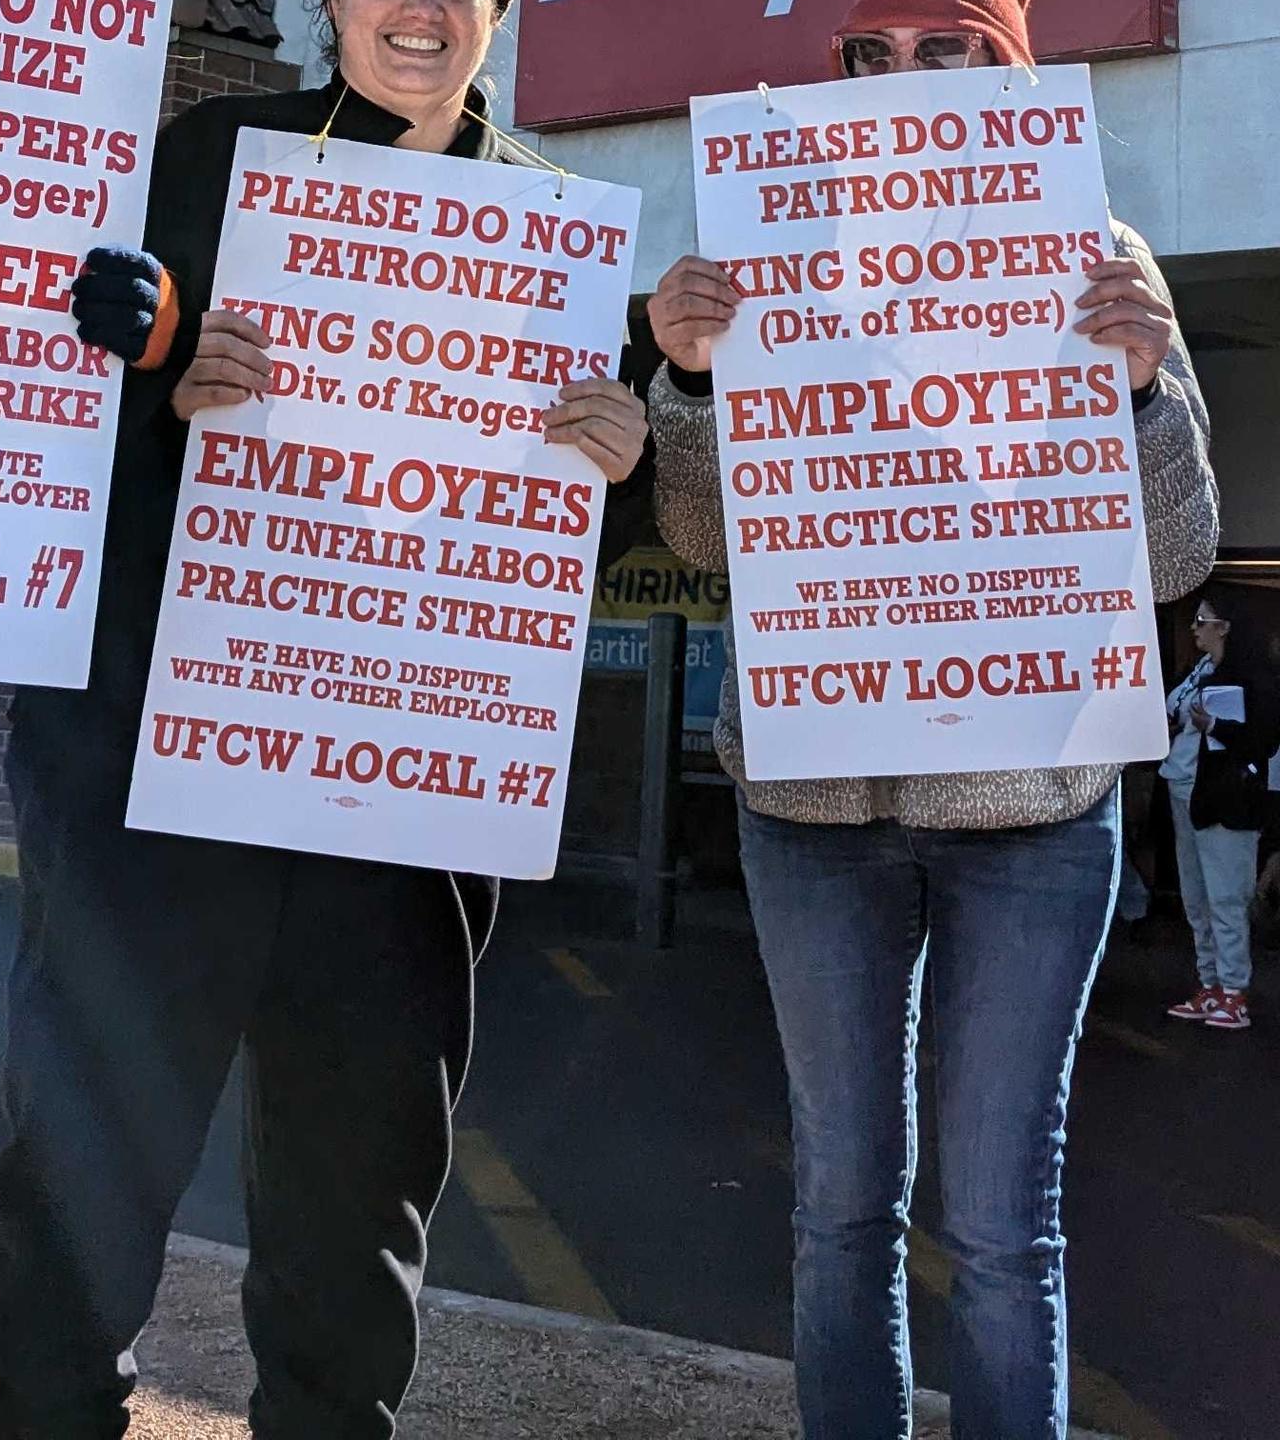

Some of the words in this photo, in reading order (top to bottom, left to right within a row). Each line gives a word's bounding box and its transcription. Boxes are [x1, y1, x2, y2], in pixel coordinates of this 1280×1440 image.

[703, 119, 882, 174] PLEASE
[889, 112, 968, 156] DO
[981, 106, 1085, 149] NOT
[238, 171, 423, 233] PLEASE
[430, 198, 510, 245] DO
[521, 212, 626, 264] NOT
[760, 163, 1042, 223] PATRONIZE
[283, 232, 568, 310] PATRONIZE
[859, 231, 1105, 289] SOOPER'S
[368, 321, 610, 386] SOOPER'S
[759, 306, 851, 355] (Div.
[859, 300, 899, 337] of
[909, 288, 1066, 339] Kroger)
[252, 360, 347, 406] Div.
[356, 376, 402, 413] of
[405, 380, 556, 445] Kroger
[724, 364, 1120, 443] EMPLOYEES
[193, 430, 593, 537] EMPLOYEES
[730, 459, 794, 497] ON
[804, 447, 968, 493] UNFAIR
[974, 437, 1130, 482] LABOR
[185, 505, 255, 547] ON
[266, 515, 426, 571] UNFAIR
[436, 539, 585, 594] LABOR
[737, 504, 962, 554] PRACTICE
[970, 495, 1133, 539] STRIKE
[24, 545, 83, 608] #7
[176, 561, 408, 627] PRACTICE
[415, 595, 577, 651] STRIKE
[598, 567, 729, 606] HIRING
[796, 580, 836, 603] WE
[843, 575, 912, 601] HAVE
[917, 573, 962, 596] NO
[967, 565, 1079, 594] DISPUTE
[749, 607, 822, 632] WITH
[826, 604, 879, 629] ANY
[884, 598, 979, 626] OTHER
[983, 589, 1136, 619] EMPLOYER
[169, 657, 244, 688] WITH
[248, 668, 306, 695] ANY
[308, 678, 403, 709] OTHER
[408, 690, 557, 730] EMPLOYER
[227, 638, 267, 664] WE
[274, 645, 343, 675] HAVE
[349, 655, 394, 681] NO
[397, 661, 509, 697] DISPUTE
[747, 660, 891, 708] UFCW
[903, 650, 1082, 701] LOCAL
[1092, 645, 1148, 689] #7
[152, 713, 304, 772] UFCW
[311, 736, 486, 800] LOCAL
[498, 763, 556, 807] #7
